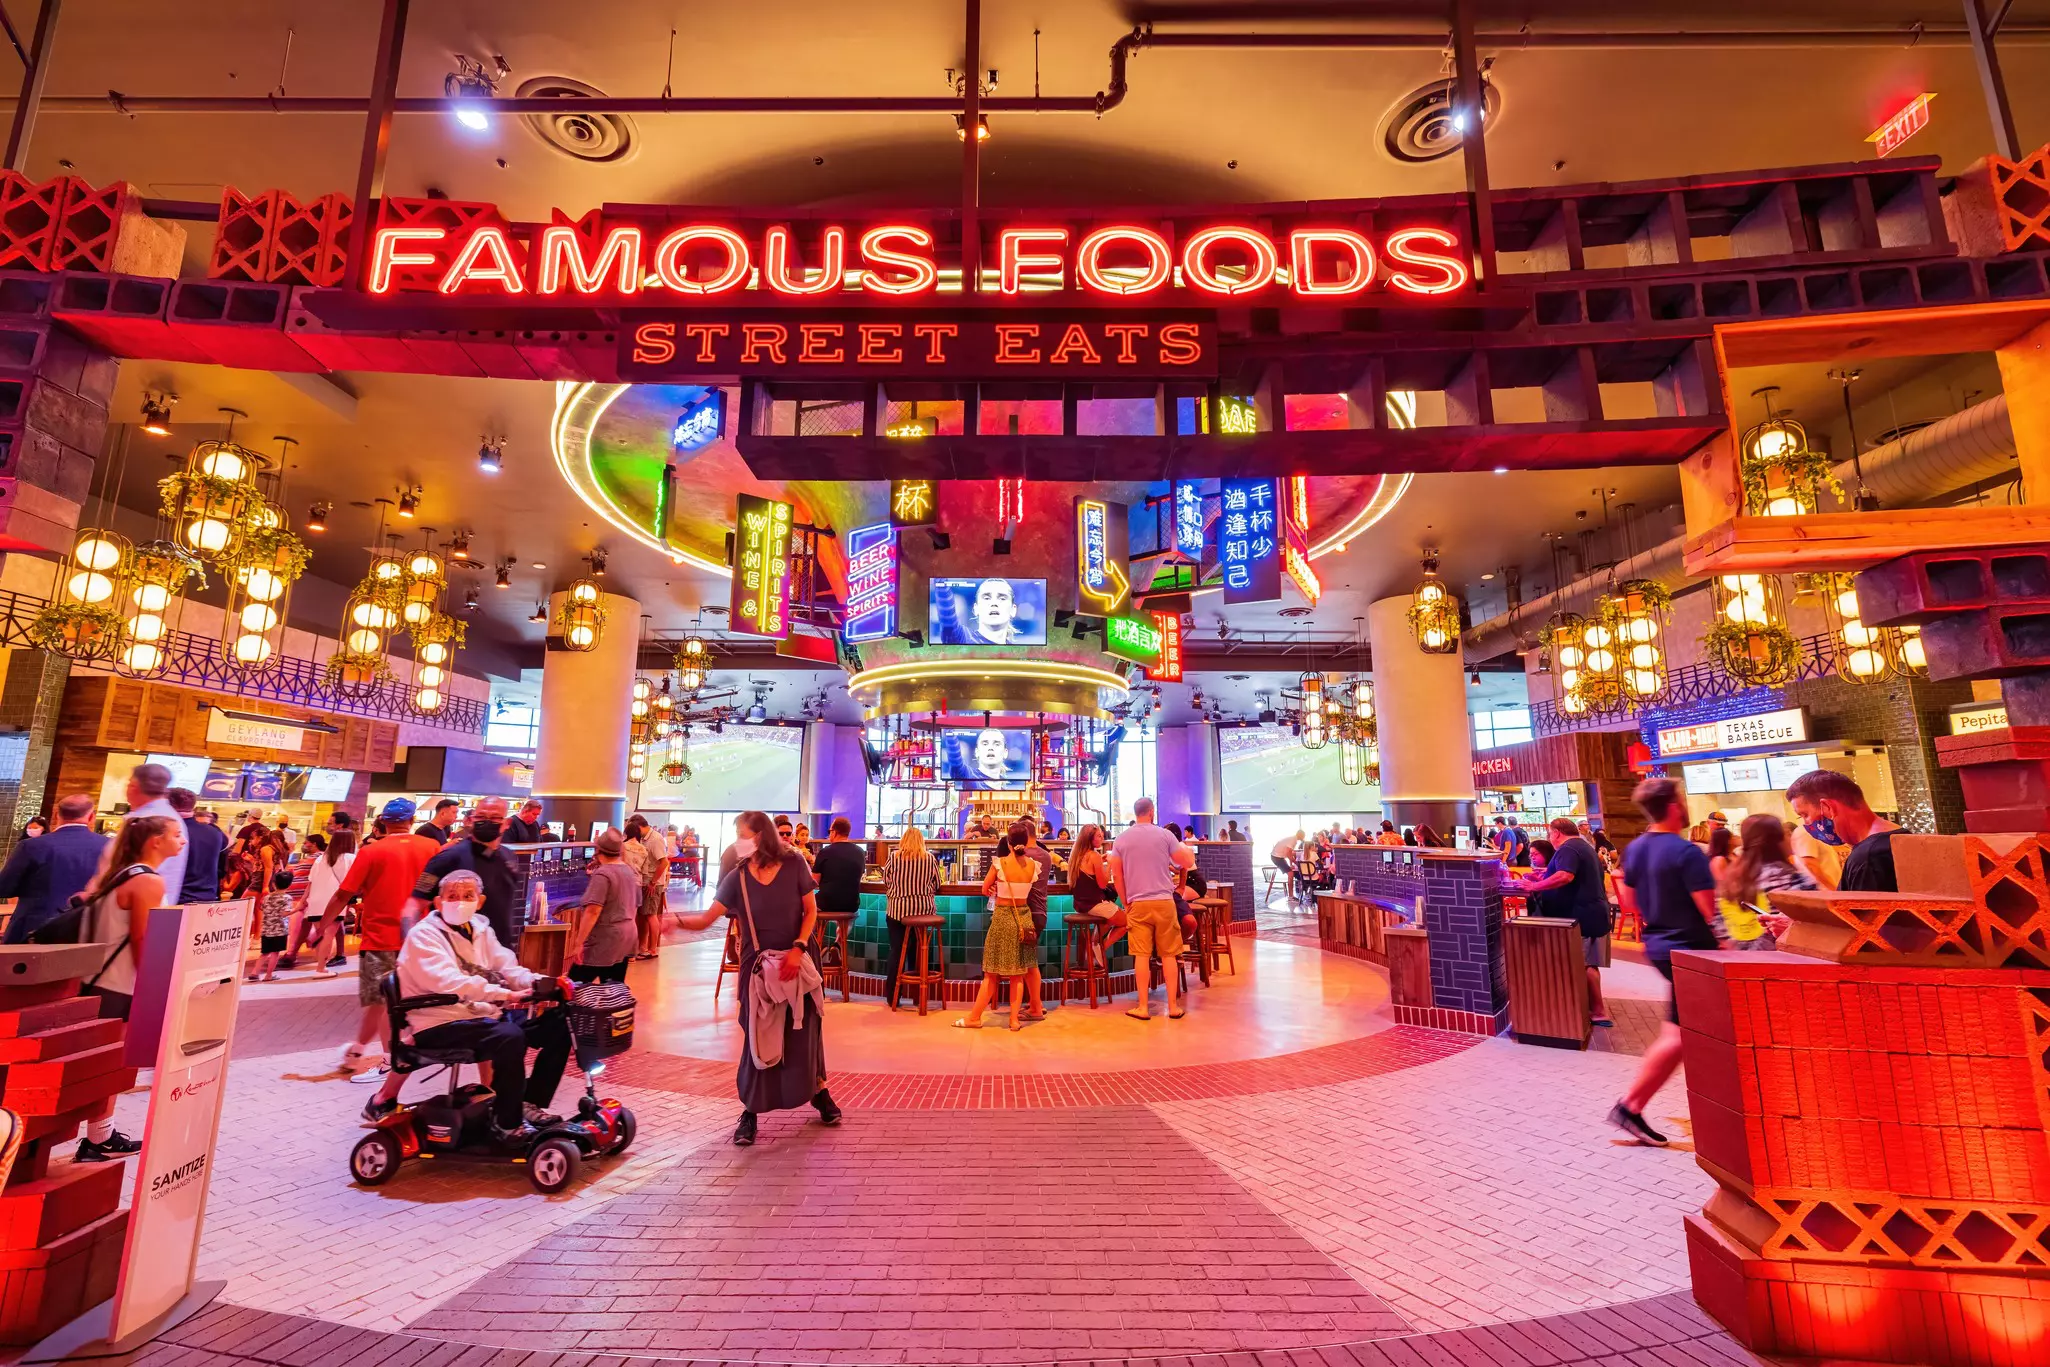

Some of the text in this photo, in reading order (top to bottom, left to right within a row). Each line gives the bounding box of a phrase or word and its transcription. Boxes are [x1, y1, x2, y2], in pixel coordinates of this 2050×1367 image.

[1884, 105, 1919, 150] EXIT
[369, 226, 1468, 296] FAMOUS FOODS
[632, 322, 1202, 365] STREET EATS
[1249, 483, 1273, 559] 千杯少
[1224, 488, 1250, 587] 酒逢知己
[742, 512, 767, 617] WINE &
[768, 502, 788, 632] SPIRITS
[849, 543, 889, 574] BEER
[849, 564, 890, 597] WINE
[847, 591, 889, 618] SPIRITS
[1166, 616, 1180, 676] BEER
[228, 723, 286, 740] GEYLANG
[1726, 719, 1764, 733] TEXAS
[1727, 726, 1793, 744] BARBECUE
[1960, 713, 2008, 728] Pepita
[226, 734, 265, 745] CLAYPOT
[1472, 757, 1511, 776] HICKEN
[192, 946, 210, 956] YOUR
[211, 943, 229, 953] HANDS
[193, 926, 242, 947] SANITIZE
[151, 1153, 206, 1192] SANITIZE
[150, 1187, 170, 1201] YOUR
[170, 1176, 191, 1193] HANDS
